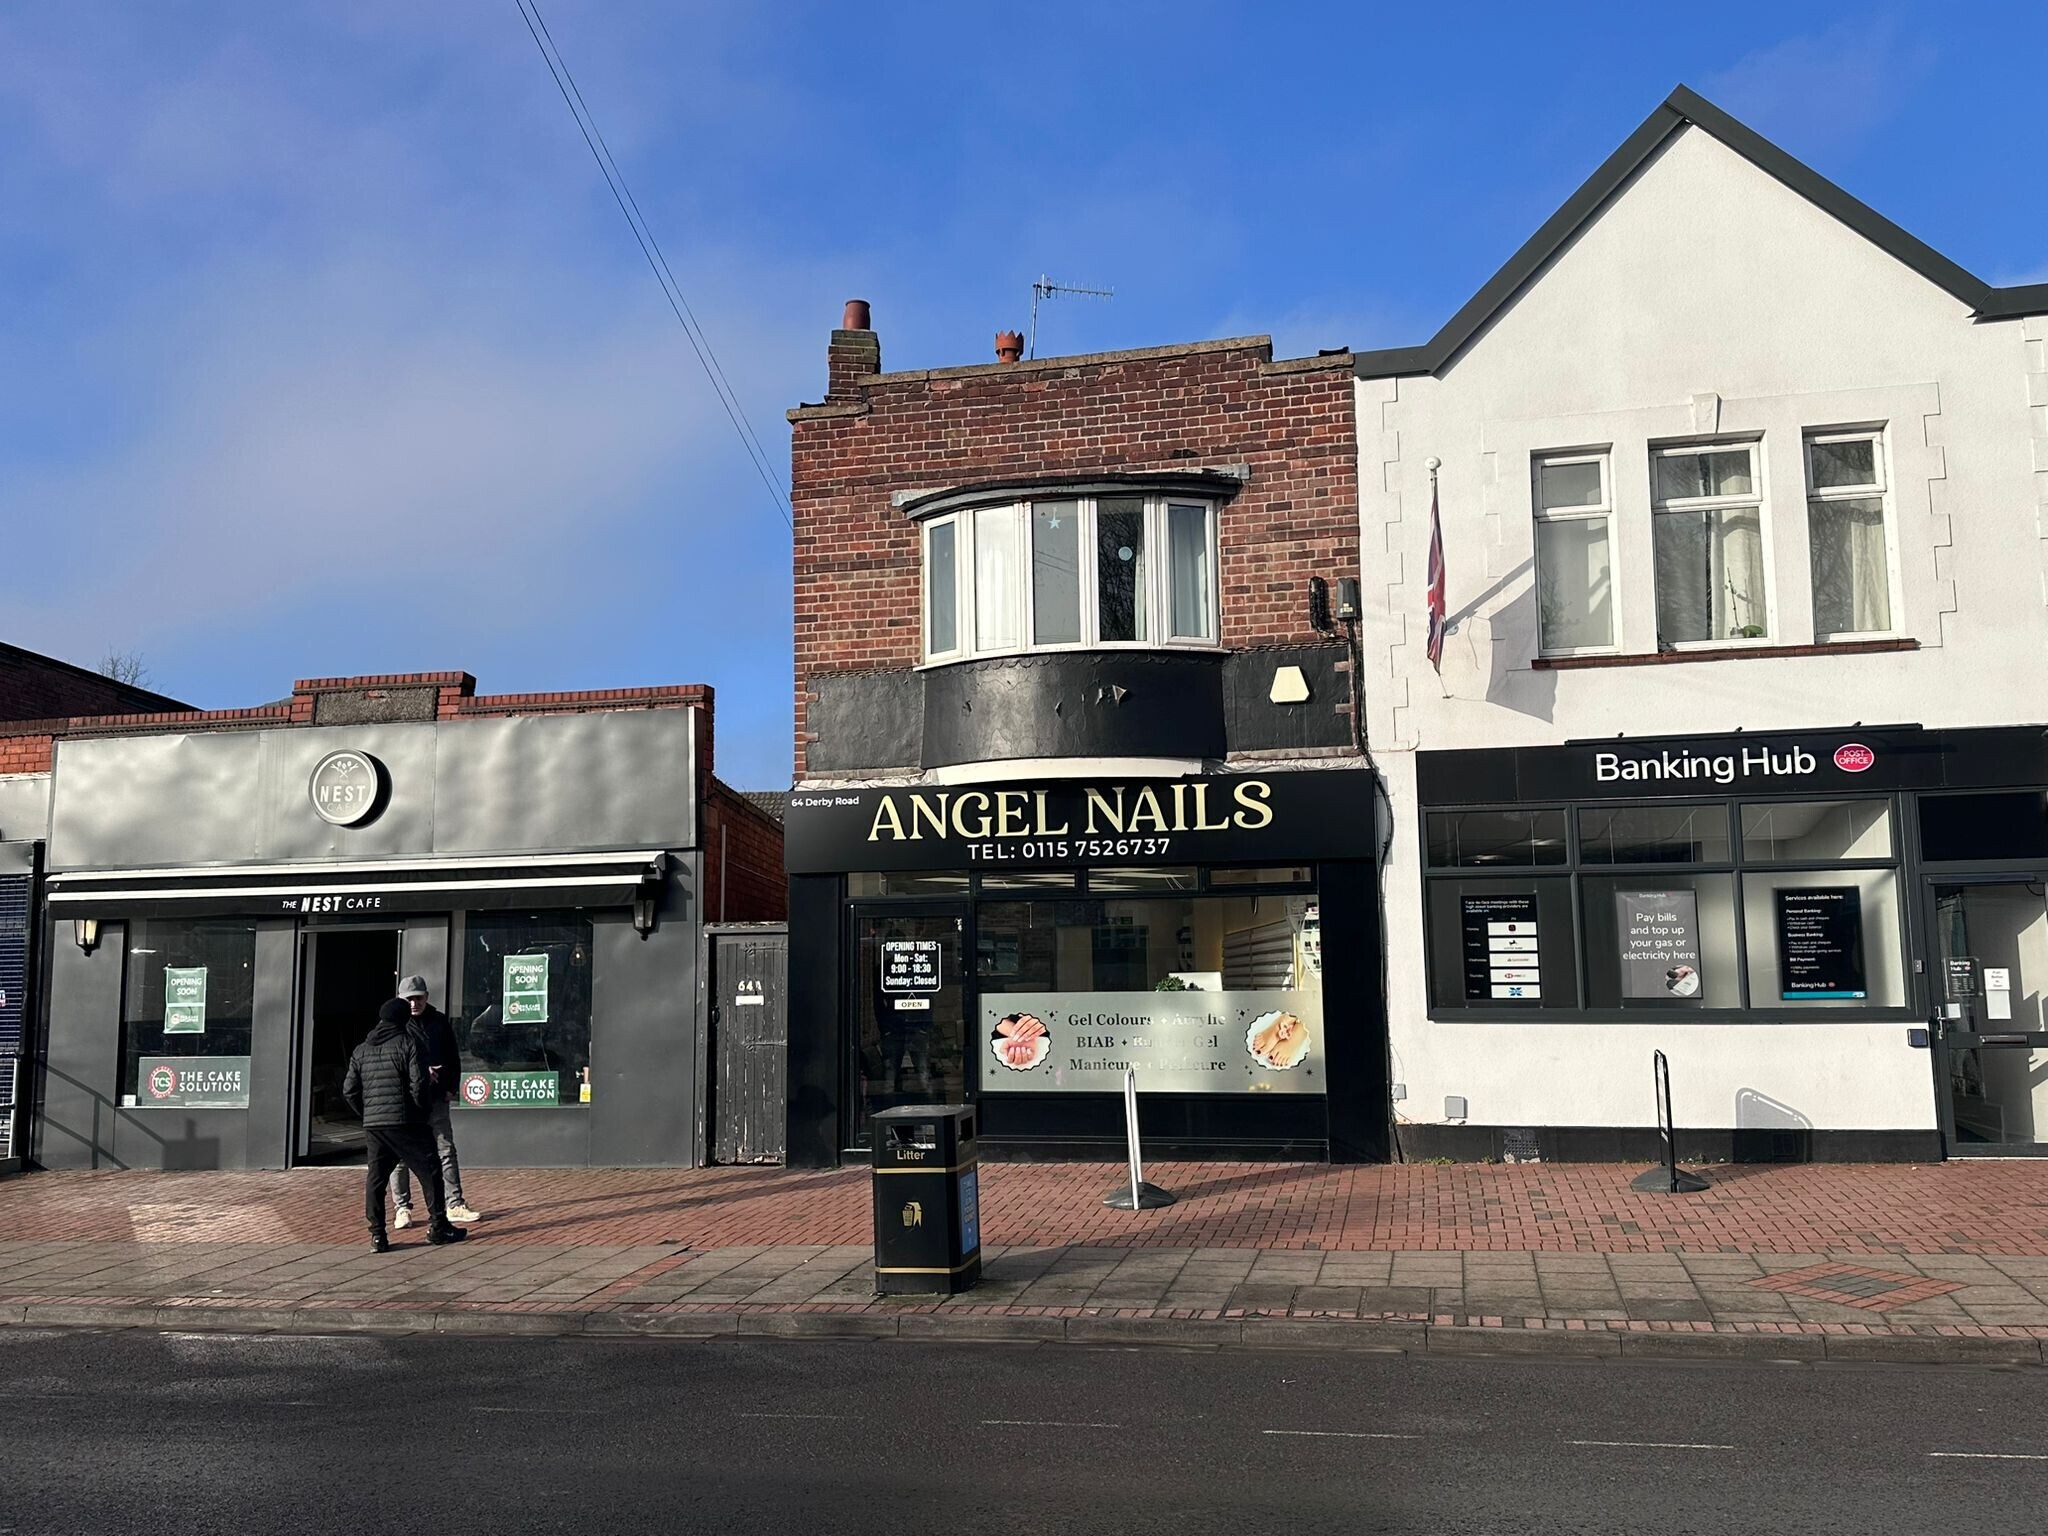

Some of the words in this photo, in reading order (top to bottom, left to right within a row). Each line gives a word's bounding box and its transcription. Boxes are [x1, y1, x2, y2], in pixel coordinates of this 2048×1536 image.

[1595, 749, 1735, 784] Banking
[1742, 745, 1817, 777] Hub
[1838, 756, 1870, 765] OFFICE
[320, 785, 367, 803] NEST
[791, 798, 804, 807] 64
[805, 797, 833, 808] Derby
[835, 796, 860, 806] Road
[867, 791, 1069, 841] ANGEL
[1083, 780, 1274, 834] NAILS
[967, 843, 1016, 860] TEL:
[1022, 841, 1069, 859] 0115
[1075, 838, 1171, 857] 7526737
[282, 900, 297, 909] THE
[300, 896, 343, 912] NEST
[346, 897, 382, 909] CAFE
[1636, 912, 1655, 924] Pay
[1657, 912, 1678, 922] bills
[1630, 925, 1649, 935] and
[1651, 926, 1669, 936] top
[1671, 927, 1686, 936] up
[886, 941, 915, 952] OPENING
[916, 941, 937, 951] TIMES
[1630, 940, 1653, 949] your
[1655, 940, 1673, 949] gas
[1675, 939, 1687, 947] or
[894, 953, 909, 963] Mon
[914, 953, 928, 963] Sat:
[1622, 951, 1671, 961] electricity
[1673, 950, 1696, 960] here
[509, 964, 545, 974] OPENING
[891, 964, 907, 974] 9:00
[912, 963, 932, 973] 18:30
[170, 977, 203, 986] OPENING
[515, 975, 539, 984] SOON
[885, 976, 913, 987] Sunday:
[914, 975, 937, 986] Closed
[738, 980, 762, 991] 64A
[176, 987, 199, 996] SOON
[1068, 1013, 1093, 1026] Gel
[1096, 1013, 1154, 1026] Colours
[1077, 1036, 1115, 1048] BIAB
[1069, 1057, 1142, 1071] Manicure
[1158, 1055, 1227, 1071] Pedcure
[153, 1076, 171, 1088] TCS
[179, 1071, 203, 1082] THE
[208, 1071, 241, 1082] CAKE
[179, 1081, 241, 1092] SOLUTION
[468, 1085, 484, 1095] TCS
[493, 1079, 517, 1090] THE
[521, 1079, 555, 1089] CAKE
[493, 1089, 555, 1099] SOLUTION
[896, 1150, 926, 1160] Litter
